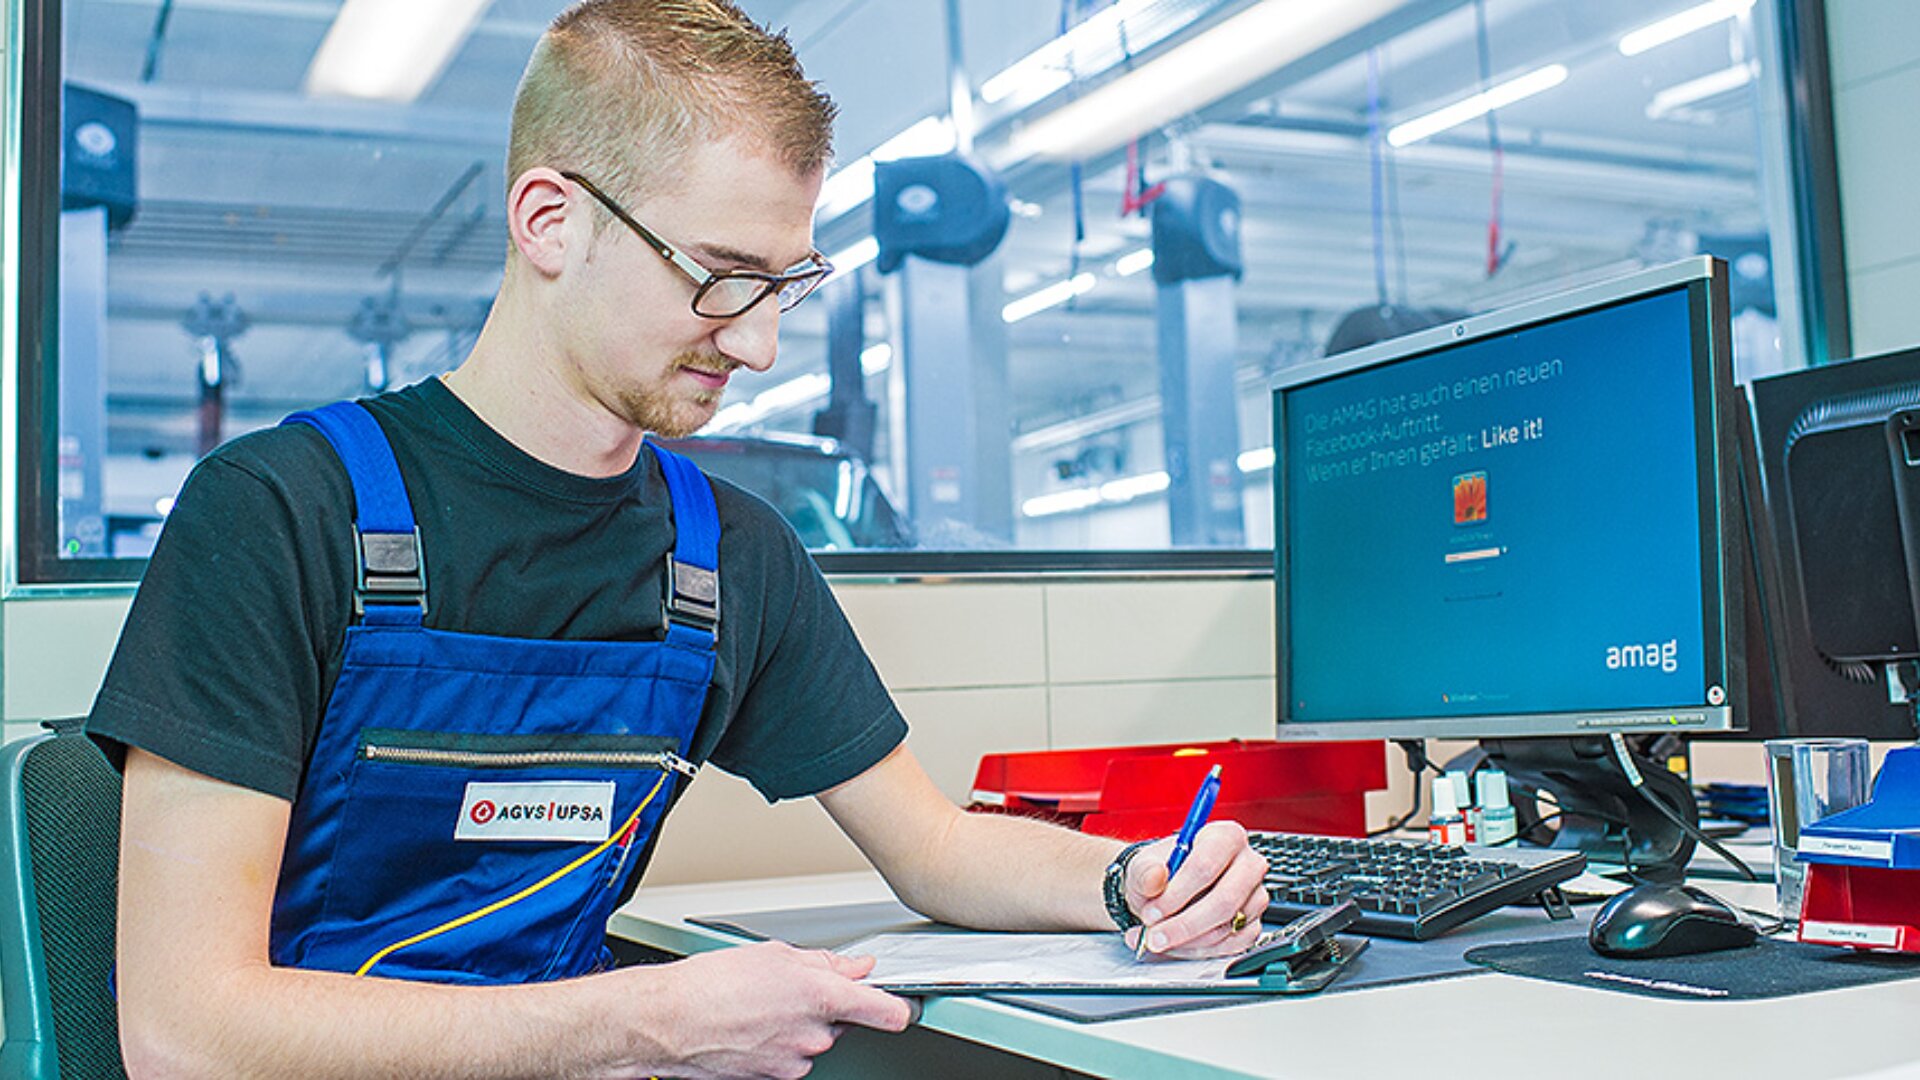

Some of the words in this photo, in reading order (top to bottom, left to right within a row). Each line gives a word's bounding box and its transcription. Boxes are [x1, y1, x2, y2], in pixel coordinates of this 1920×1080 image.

[1304, 412, 1329, 434] Die
[1331, 398, 1377, 426] AMAG
[1380, 395, 1406, 416] hat
[1410, 383, 1450, 411] auch
[1453, 373, 1501, 400] einen
[1505, 358, 1563, 388] neuen
[1351, 457, 1368, 475] er
[1482, 425, 1519, 449] Like
[1523, 417, 1543, 440] it!
[1606, 639, 1677, 673] amag
